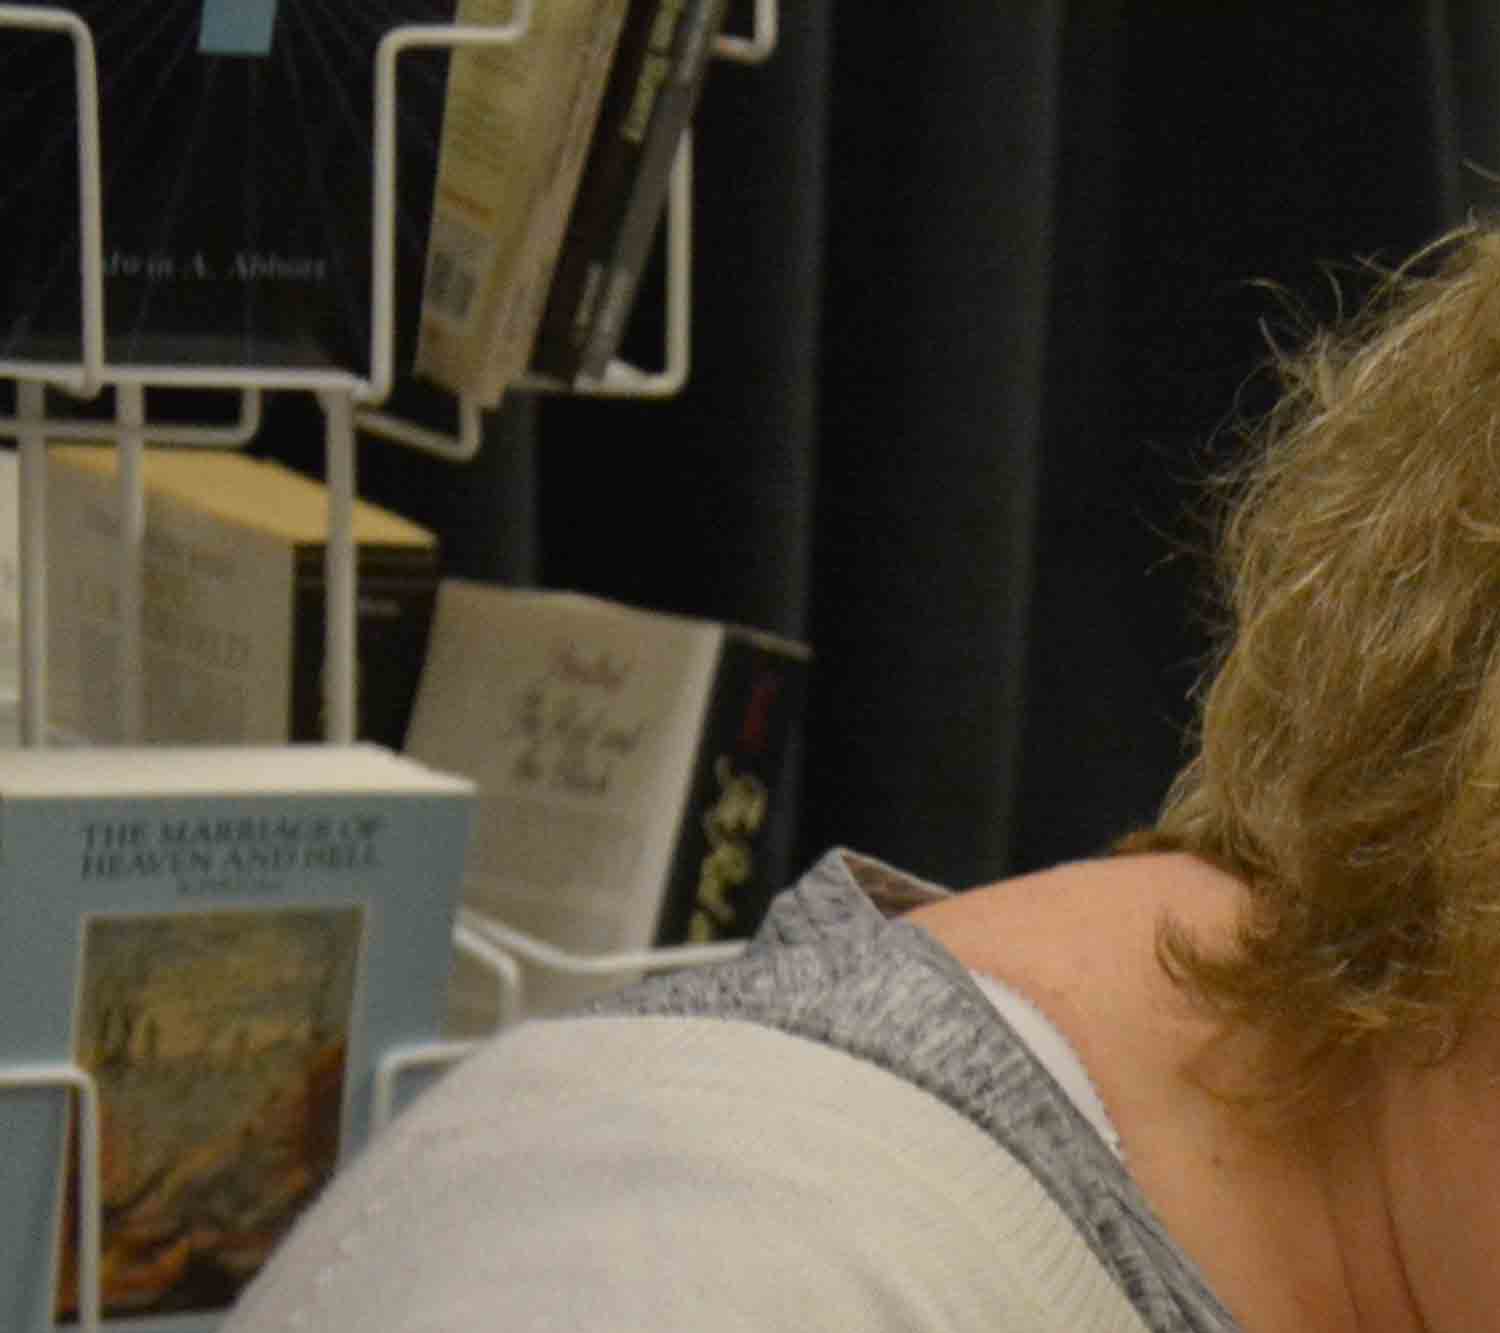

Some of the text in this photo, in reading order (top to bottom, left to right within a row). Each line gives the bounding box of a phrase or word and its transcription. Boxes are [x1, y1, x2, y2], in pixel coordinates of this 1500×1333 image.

[82, 822, 146, 852] THE
[158, 815, 334, 849] MARRIAGE
[81, 850, 212, 881] HEAVEN
[224, 847, 298, 874] AND
